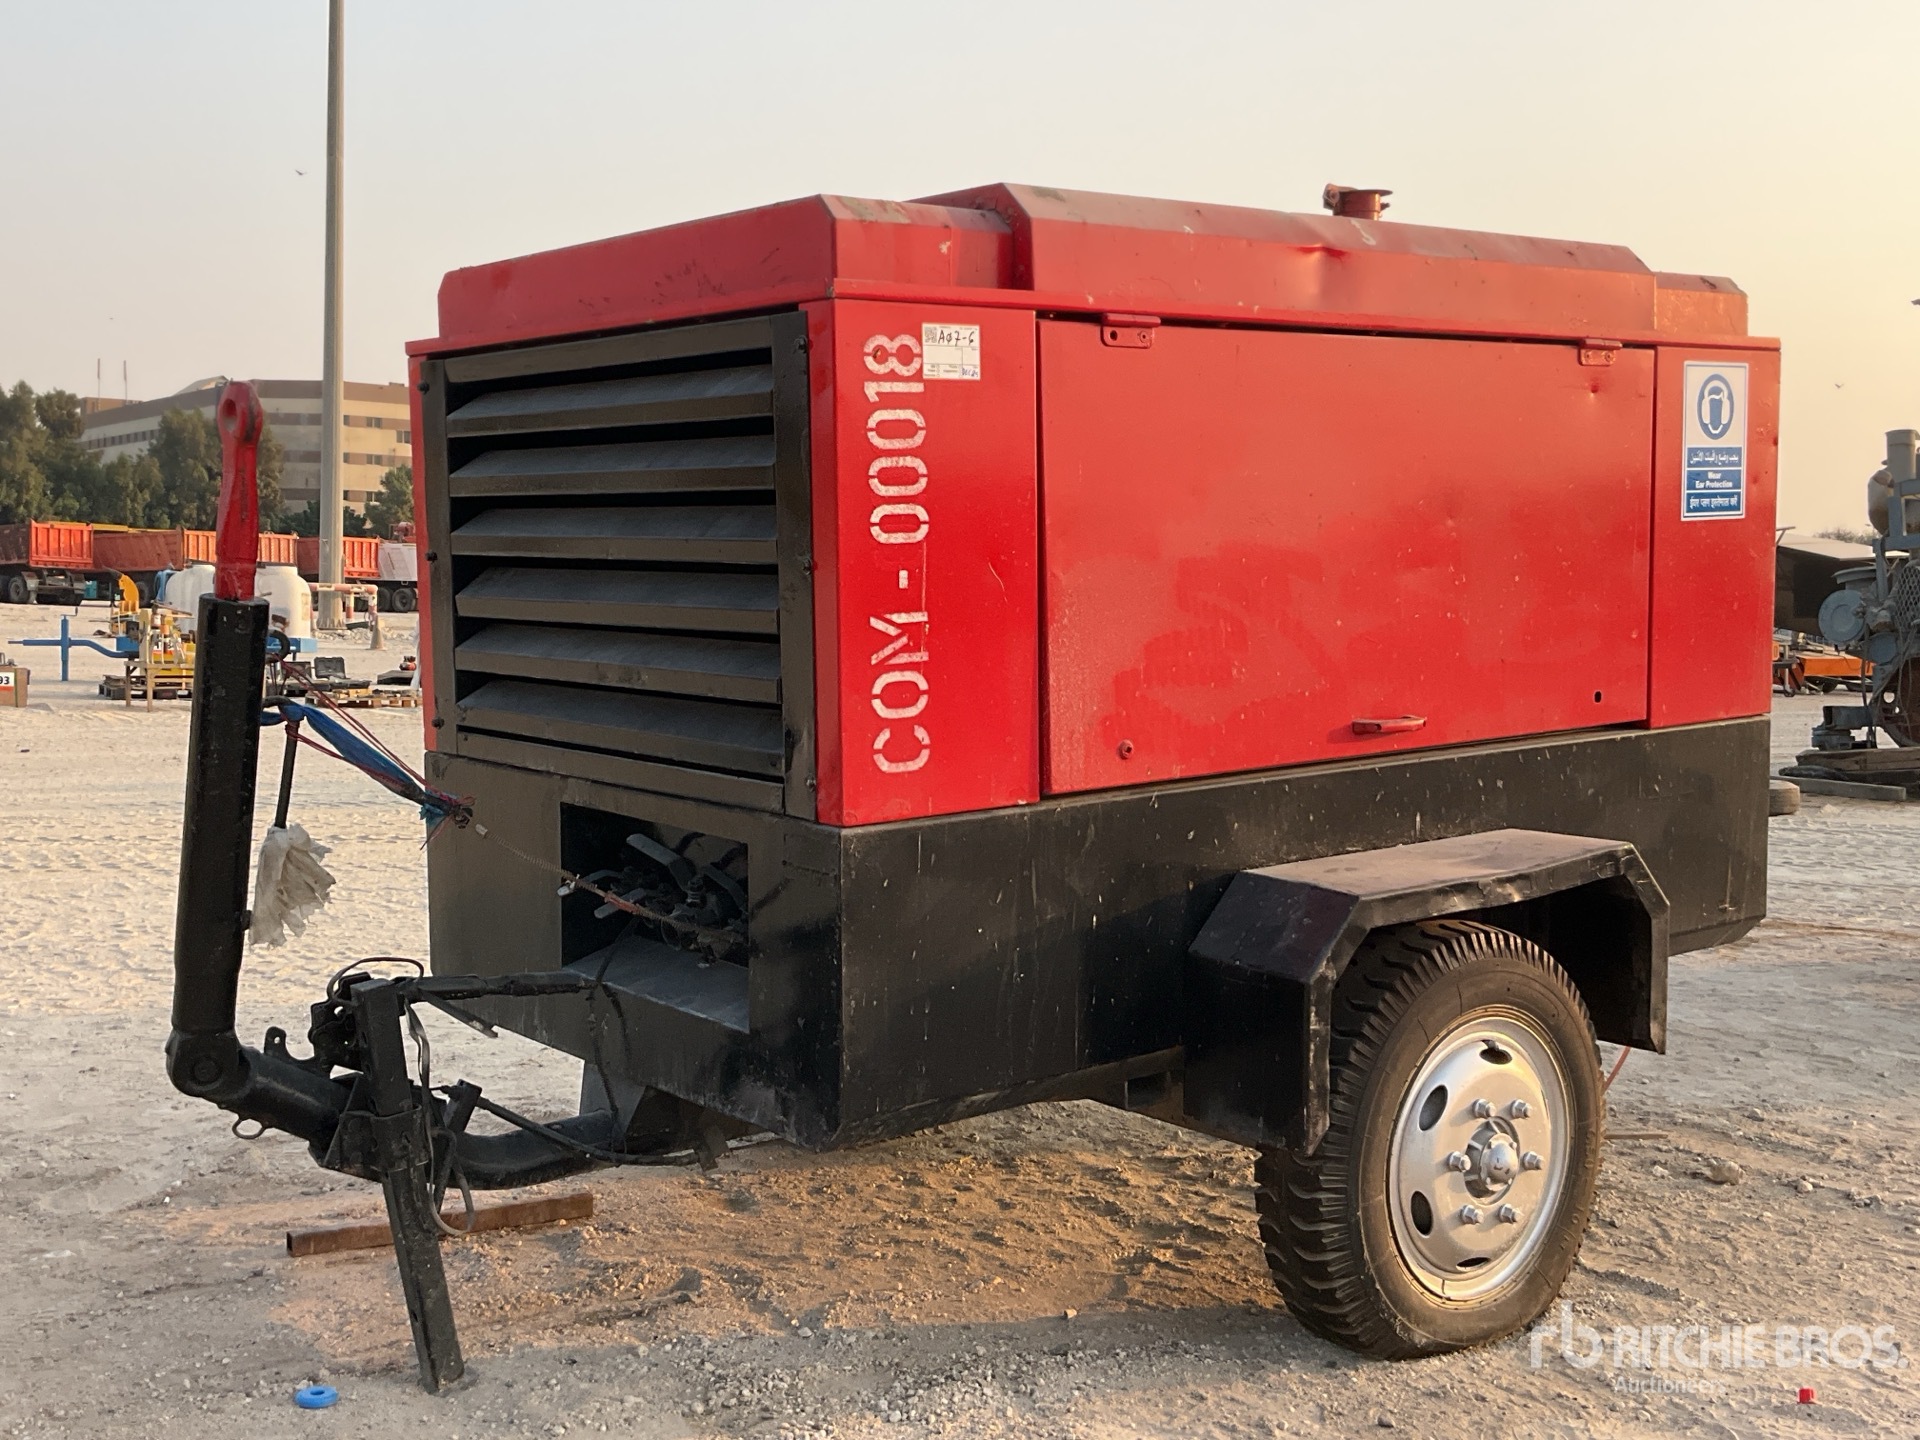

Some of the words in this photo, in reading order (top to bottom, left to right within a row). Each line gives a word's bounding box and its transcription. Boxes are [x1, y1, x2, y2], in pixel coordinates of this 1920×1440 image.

[1708, 471, 1721, 479] Wear
[1695, 480, 1705, 488] Ear
[1705, 480, 1733, 488] Protection
